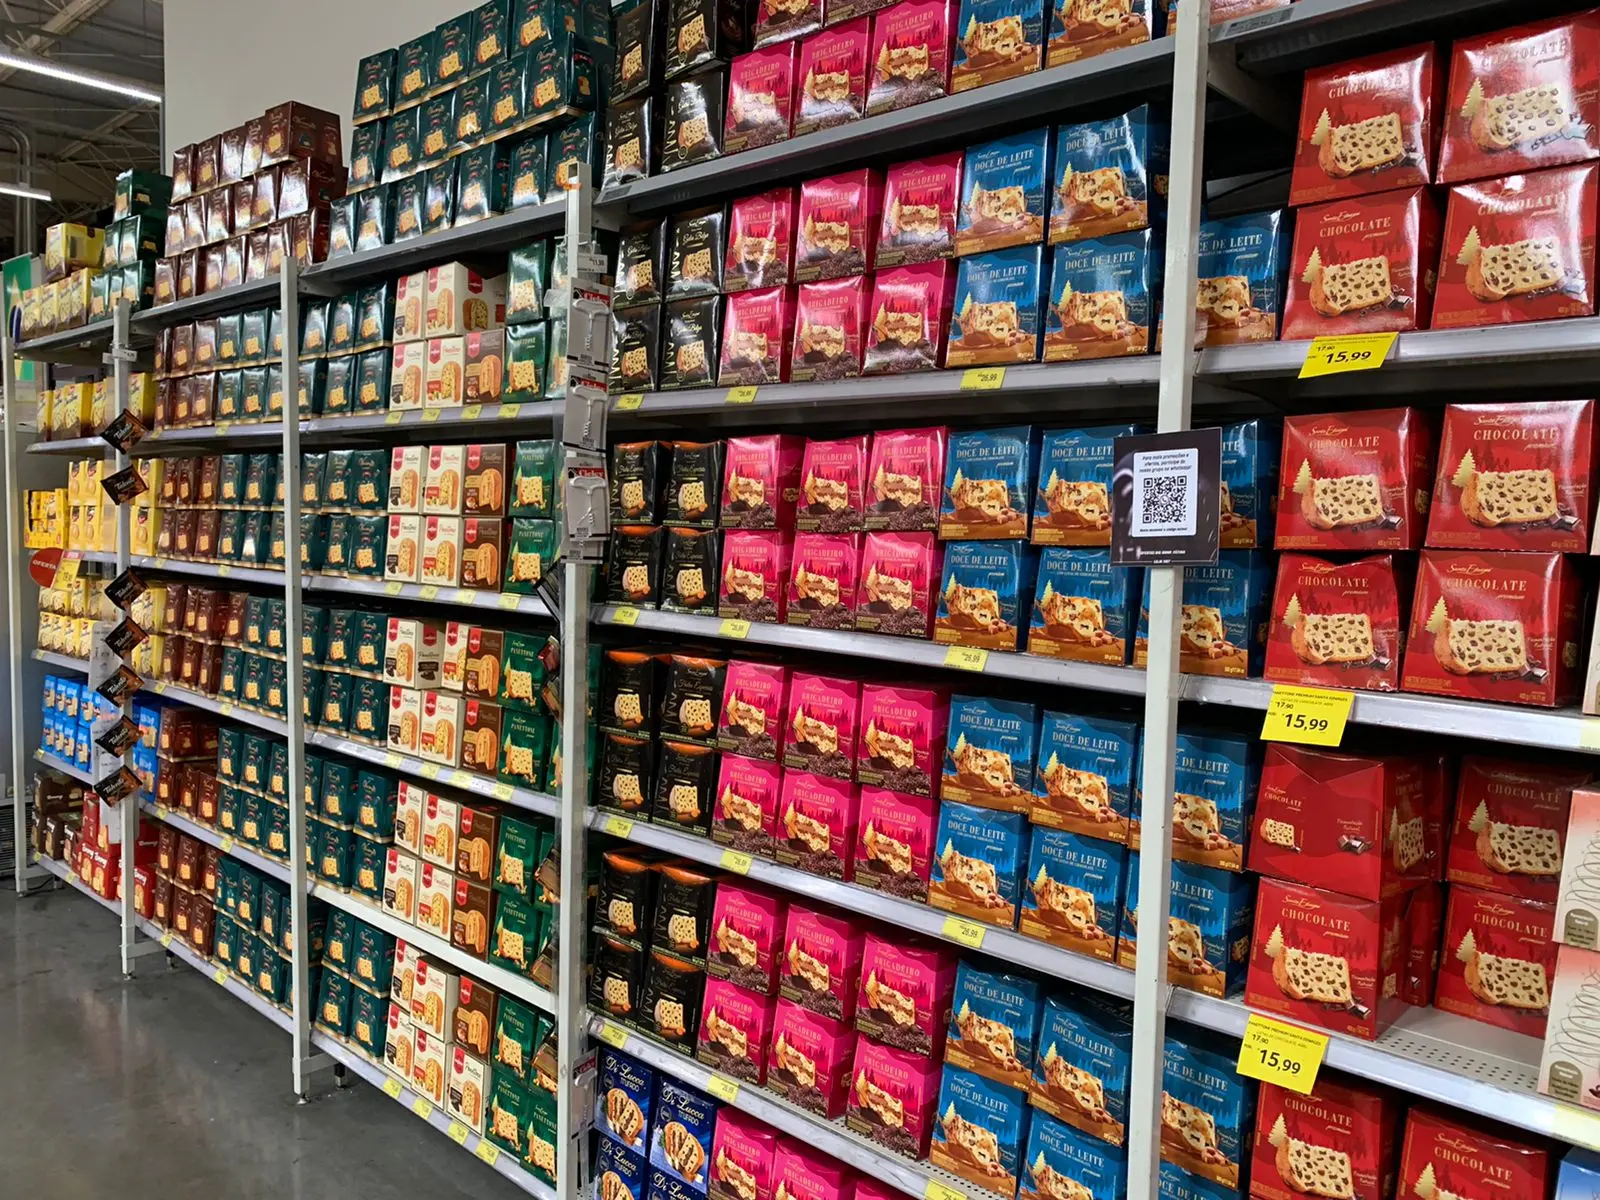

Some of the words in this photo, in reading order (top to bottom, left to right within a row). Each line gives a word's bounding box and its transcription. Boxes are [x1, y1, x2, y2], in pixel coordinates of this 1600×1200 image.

[884, 10, 934, 33] BRIGADEIRO
[811, 38, 855, 60] BRIGADEIRO
[975, 159, 996, 172] DOCE
[997, 156, 1008, 167] DE
[1009, 149, 1034, 163] LEITE
[898, 172, 947, 189] BRIGADEIRO
[1319, 217, 1391, 237] CHOCOLATE
[1210, 238, 1228, 251] DE
[1229, 233, 1263, 249] LEITE
[1064, 256, 1089, 271] DOCE
[1091, 253, 1104, 265] DE
[1106, 251, 1136, 264] LEITE
[966, 270, 986, 283] DOCE
[989, 268, 1000, 279] DE
[1002, 265, 1028, 278] LEITE
[735, 304, 772, 317] BRIGADEIRO
[807, 295, 849, 309] BRIGADEIRO
[1327, 351, 1371, 364] 15,99
[1308, 436, 1380, 449] CHOCOLATE
[1473, 428, 1560, 441] CHOCOLATE
[812, 452, 853, 462] BRIGADEIRO
[956, 448, 976, 458] DOCE
[978, 447, 989, 456] DE
[990, 445, 1018, 457] LEITE
[1051, 448, 1073, 458] DOCE
[1074, 446, 1086, 457] DE
[1088, 445, 1113, 456] LEIT
[731, 546, 768, 555] BRIGADEIRO
[803, 549, 844, 558] BRIGADEIRO
[875, 549, 919, 559] BRIGADEIRO
[32, 560, 56, 569] OFERTA
[951, 555, 971, 565] DOCE
[973, 555, 985, 565] DE
[986, 555, 1009, 566] LEITE
[1046, 560, 1068, 572] DOCE
[1070, 561, 1081, 572] DE
[1185, 568, 1199, 577] DE
[1202, 568, 1234, 579] LEITE
[1297, 576, 1369, 588] CHOCOLATE
[1446, 578, 1527, 593] CHOCOLATE
[735, 679, 771, 691] BRIGADEIRO
[801, 693, 843, 705] BRIGADEIRO
[872, 705, 918, 718] BRIGADEIRO
[960, 714, 981, 725] DOCE
[983, 716, 995, 727] DE
[997, 719, 1022, 731] LEITE
[1285, 713, 1328, 731] 15,99
[1052, 731, 1072, 743] DOCE
[1078, 735, 1091, 746] DE
[1094, 738, 1120, 752] LEITE
[1182, 756, 1196, 768] DE
[1198, 758, 1230, 774] LEITE
[729, 771, 767, 785] BRIGADEIRO
[792, 788, 836, 804] BRIGADEIRO
[1264, 791, 1302, 807] CHOCOLATE
[1487, 783, 1562, 804] CHOCOLATE
[871, 807, 917, 823] BRIGADEIRO
[947, 820, 968, 832] DOCE
[969, 824, 981, 834] DE
[982, 827, 1007, 841] LEITE
[1041, 845, 1063, 857] DOCE
[1067, 848, 1079, 860] DE
[1081, 853, 1108, 869] LEITE
[1171, 880, 1183, 892] DE
[1185, 884, 1214, 900] LEITE
[724, 904, 763, 922] BRIGADEIRO
[1281, 908, 1351, 932] CHOCOLATE
[1473, 913, 1548, 938] CHOCOLATE
[795, 927, 835, 945] BRIGADEIRO
[873, 956, 921, 977] BRIGADEIRO
[963, 981, 984, 994] DOCE
[987, 988, 1000, 999] DE
[1002, 992, 1024, 1007] LEITE
[714, 994, 753, 1014] BRIGADEIRO
[783, 1021, 822, 1041] BRIGADEIRO
[1052, 1021, 1073, 1038] DOCE
[1075, 1029, 1085, 1041] DE
[1087, 1036, 1115, 1058] LEITE
[606, 1055, 620, 1073] Di
[620, 1063, 645, 1086] Lucca
[863, 1056, 909, 1079] BRIGADEIRO
[1260, 1050, 1301, 1074] 15,99
[1182, 1067, 1195, 1080] DE
[1198, 1072, 1228, 1092] LEITE
[662, 1086, 676, 1106] Di
[677, 1096, 704, 1120] Lucca
[950, 1083, 970, 1098] DOCE
[972, 1092, 984, 1103] DE
[985, 1095, 1009, 1114] LEITE
[1284, 1098, 1353, 1127] CHOCOLATE
[602, 1138, 614, 1155] Di
[614, 1147, 637, 1171] Lucca
[722, 1133, 761, 1158] BRIGADEIRO
[1039, 1131, 1061, 1149] DOCE
[1063, 1140, 1075, 1152] DE
[1077, 1147, 1105, 1169] LEITE
[1433, 1147, 1513, 1181] CHOCOLATE
[654, 1173, 666, 1190] Di
[783, 1167, 825, 1193] BRIGADEIRO
